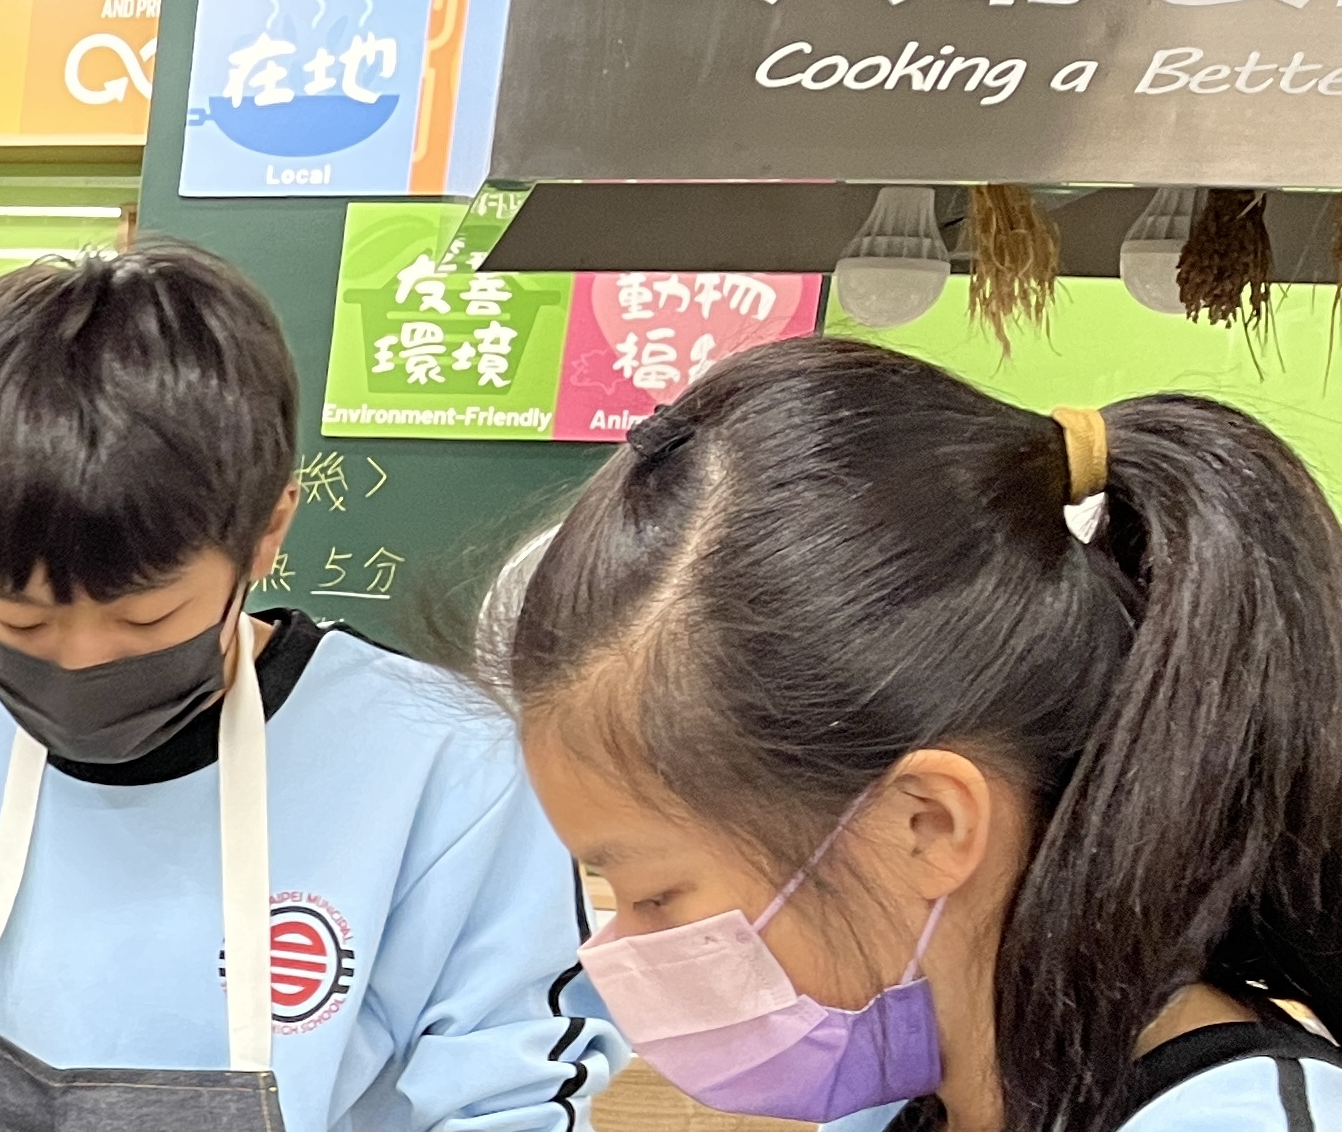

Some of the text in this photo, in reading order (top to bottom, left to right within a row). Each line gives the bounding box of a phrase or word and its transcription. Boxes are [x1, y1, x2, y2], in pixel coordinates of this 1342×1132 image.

[100, 0, 160, 18] AND PR
[222, 31, 398, 108] 在地
[755, 41, 1342, 106] Cooking a Bette
[266, 164, 332, 185] Local
[394, 253, 513, 315] 友善
[615, 272, 777, 321] 動物
[371, 320, 518, 388] 環境
[322, 403, 553, 433] Environment-Friendly
[269, 891, 304, 905] AIPEI
[300, 998, 347, 1034] SCHOOL
